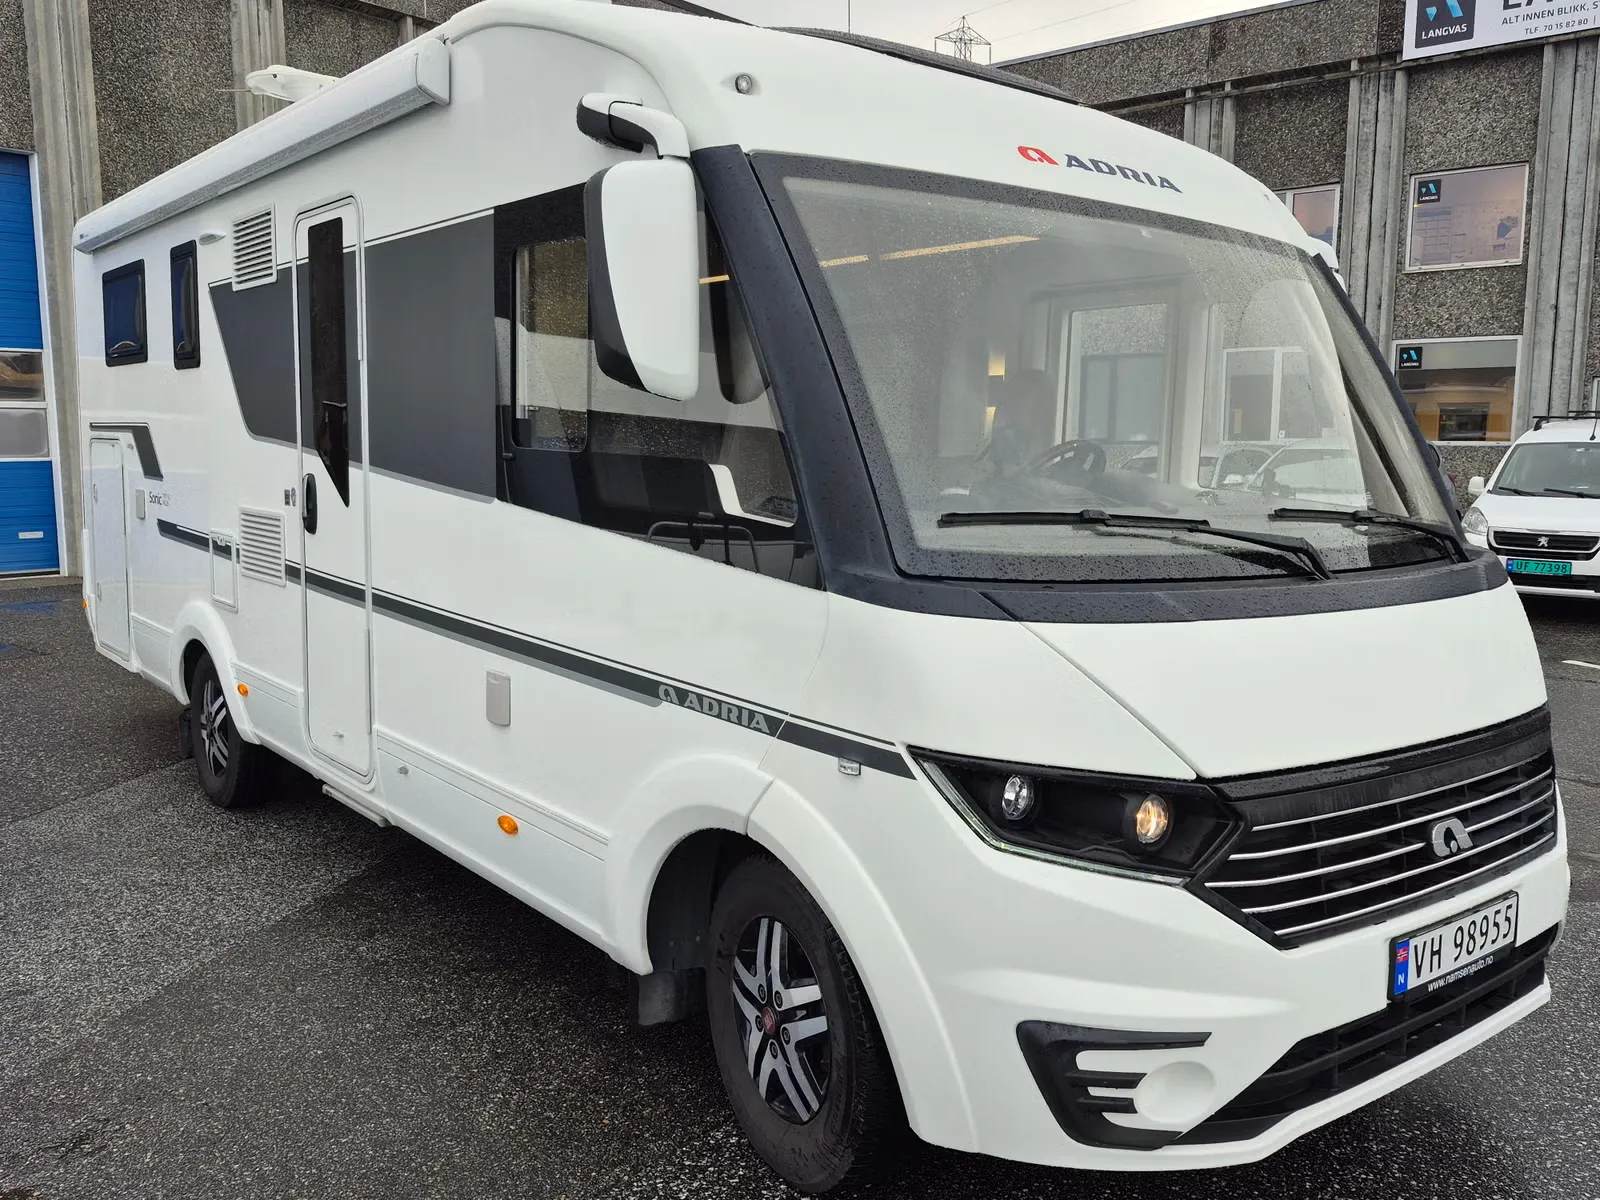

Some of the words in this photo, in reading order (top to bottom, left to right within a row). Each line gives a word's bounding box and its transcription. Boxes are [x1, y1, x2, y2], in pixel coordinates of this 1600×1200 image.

[1501, 15, 1521, 26] ALT
[1522, 9, 1555, 22] INNEN
[1557, 3, 1590, 16] BLIKK,
[1592, 0, 1600, 10] S
[1421, 23, 1467, 40] LANGVAS
[1525, 27, 1541, 35] TLF.
[1555, 22, 1564, 30] 15
[1565, 20, 1576, 28] 82
[1577, 18, 1589, 26] 80
[1064, 153, 1184, 194] ADRIA
[148, 491, 163, 506] Sonic
[1515, 561, 1530, 571] UF
[1534, 562, 1568, 574] 77398
[683, 692, 771, 733] ADRIA
[1413, 934, 1443, 979] VH
[1453, 903, 1513, 963] 98955
[1397, 972, 1405, 986] N
[1427, 954, 1494, 993] www.namsenauto.no
